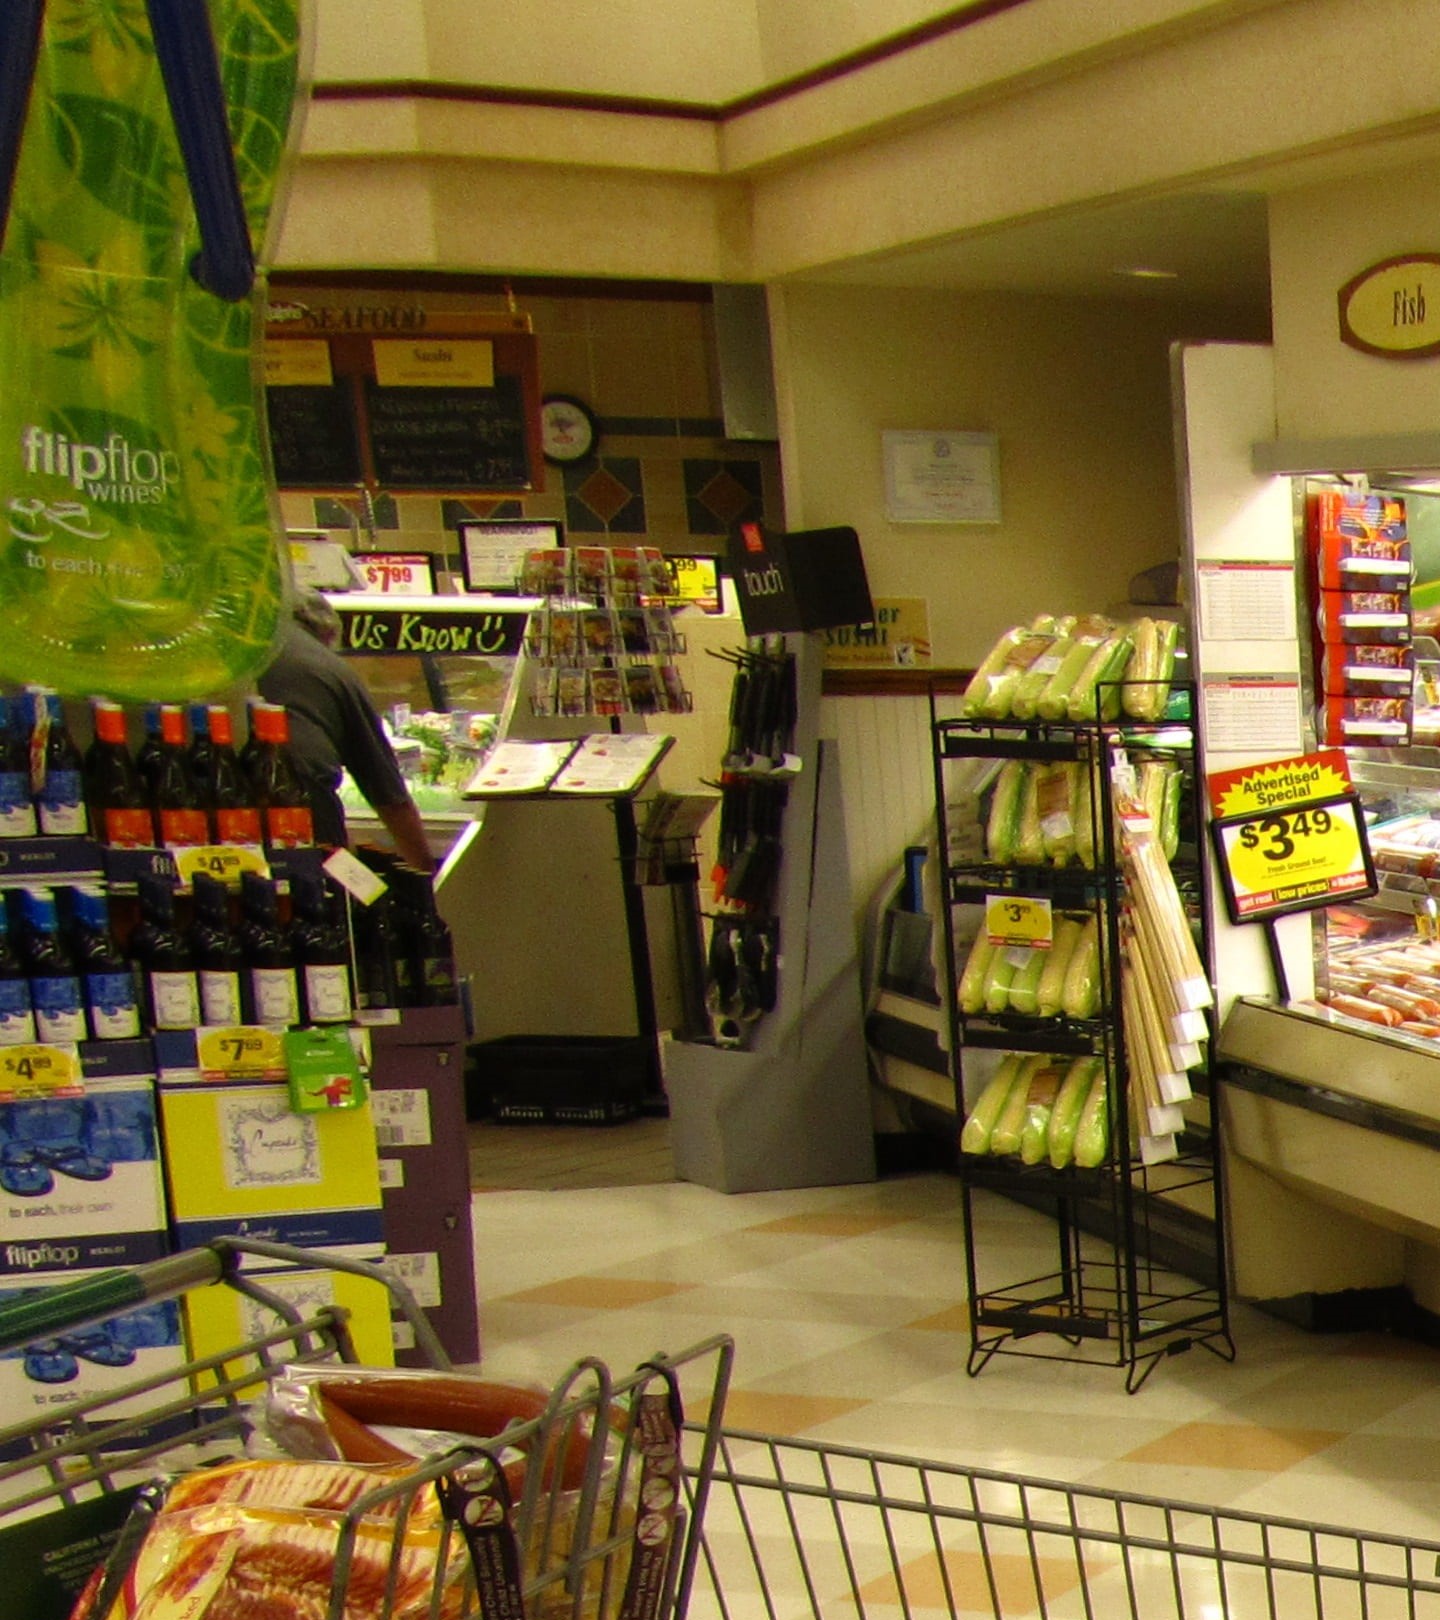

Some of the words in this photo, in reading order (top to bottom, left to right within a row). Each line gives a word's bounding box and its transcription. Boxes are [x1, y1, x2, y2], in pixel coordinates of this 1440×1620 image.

[1392, 284, 1426, 327] Fish
[22, 424, 181, 493] flipflop
[89, 484, 163, 504] wines
[25, 550, 46, 569] to
[744, 563, 784, 597] touch
[350, 614, 388, 650] Us
[399, 613, 471, 652] Know
[1243, 768, 1321, 795] Advertised
[1256, 783, 1312, 806] Special
[6, 1243, 80, 1269] flipflop
